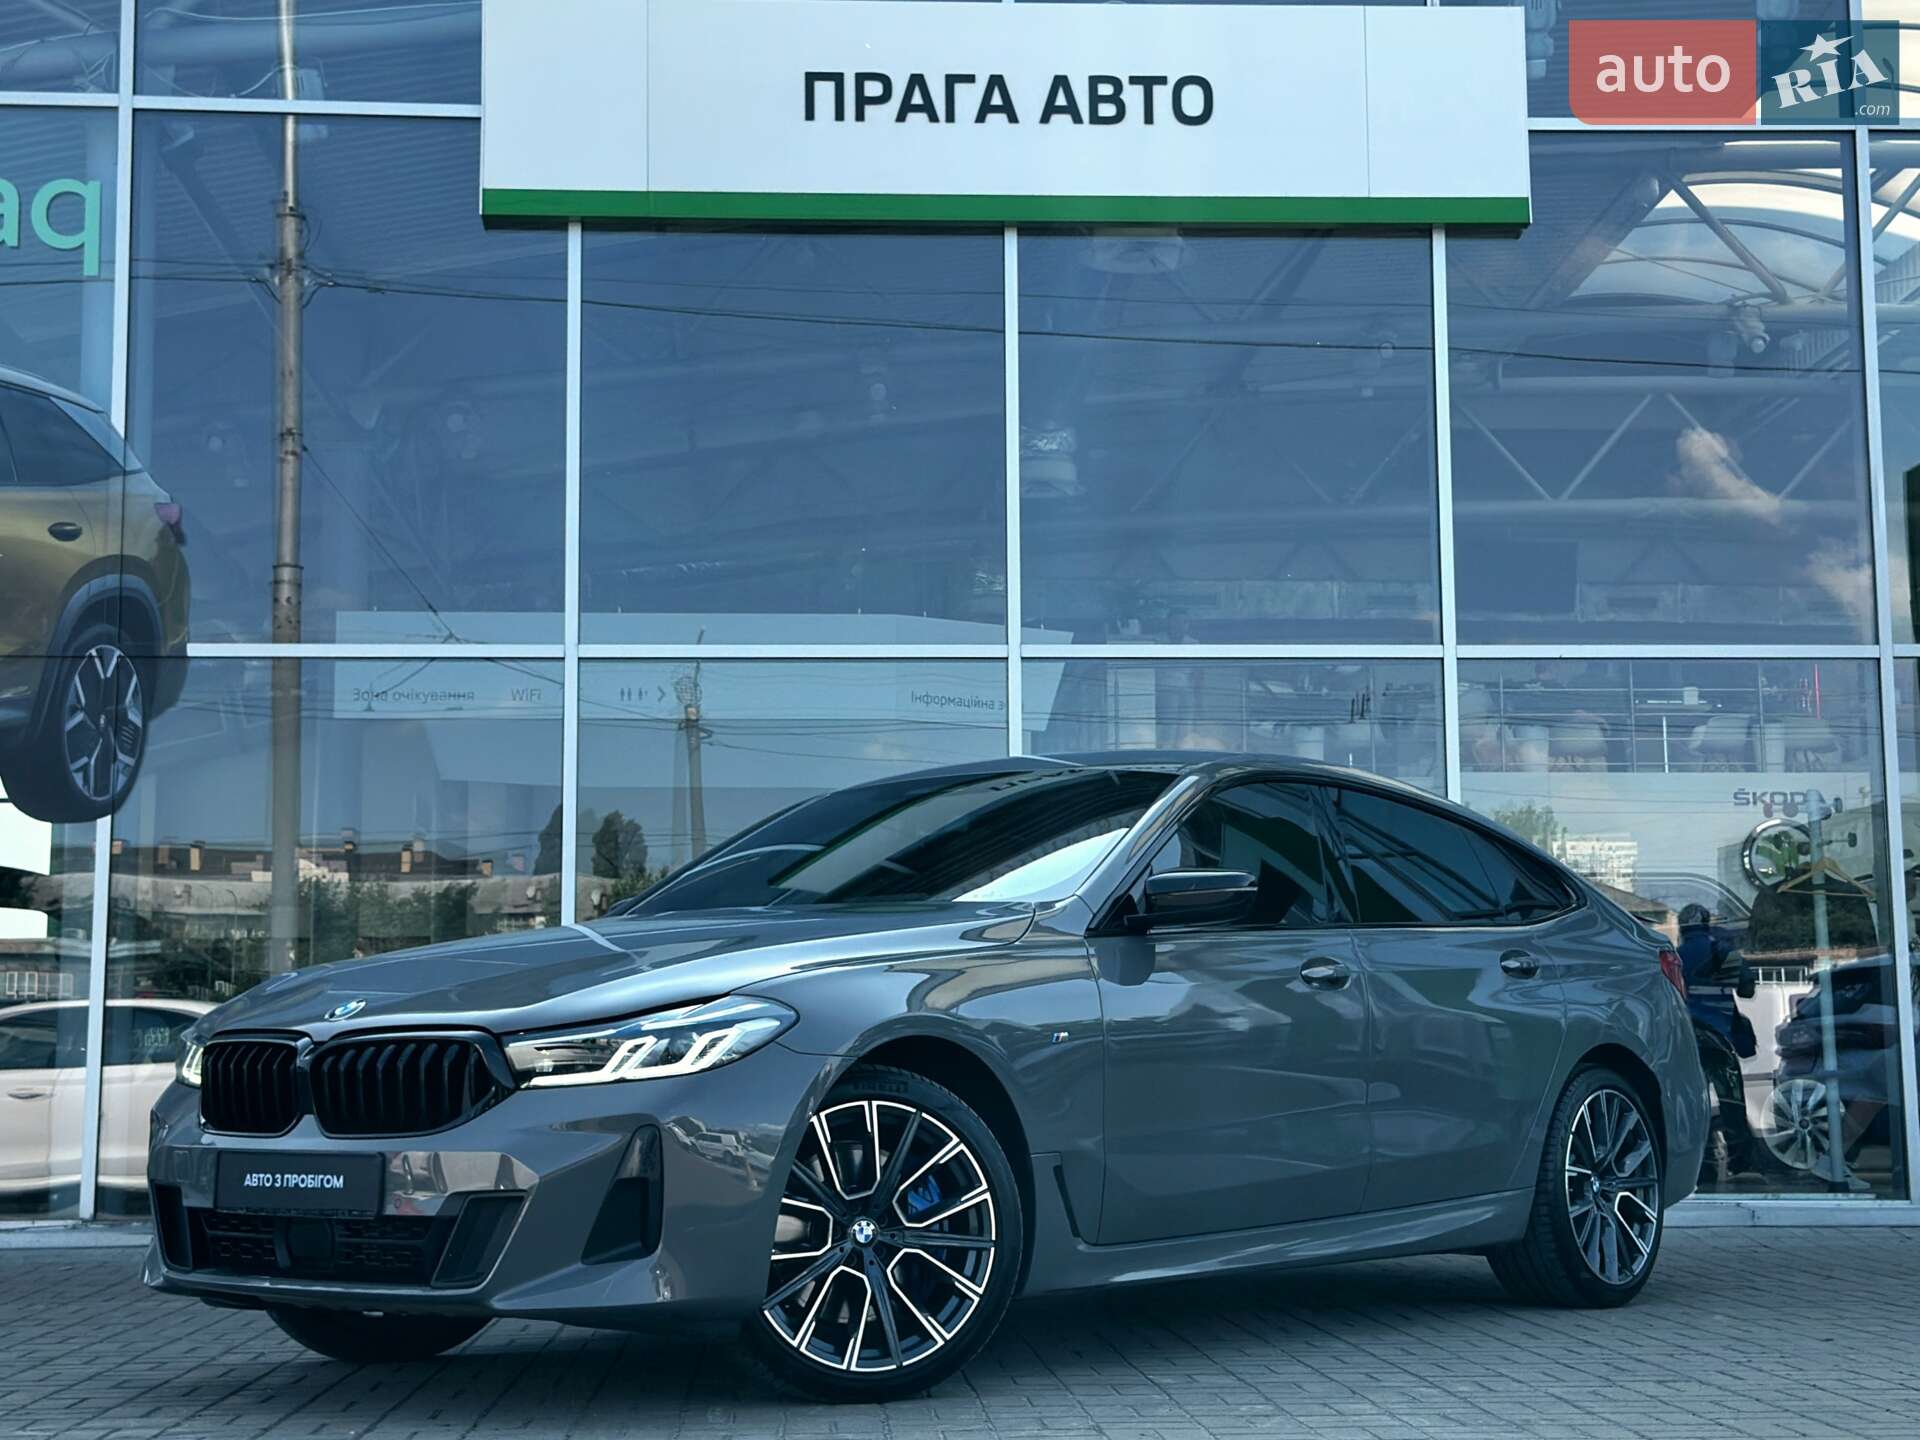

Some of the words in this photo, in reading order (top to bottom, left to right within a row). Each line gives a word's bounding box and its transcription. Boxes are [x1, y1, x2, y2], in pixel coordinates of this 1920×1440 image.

[804, 71, 1019, 124] ПРАГА
[1039, 74, 1214, 126] АВТО
[511, 688, 542, 702] WiFi
[911, 690, 995, 710] Інформаційна
[244, 1173, 273, 1187] АВТО
[283, 1174, 344, 1189] ПРОБІГОМ
